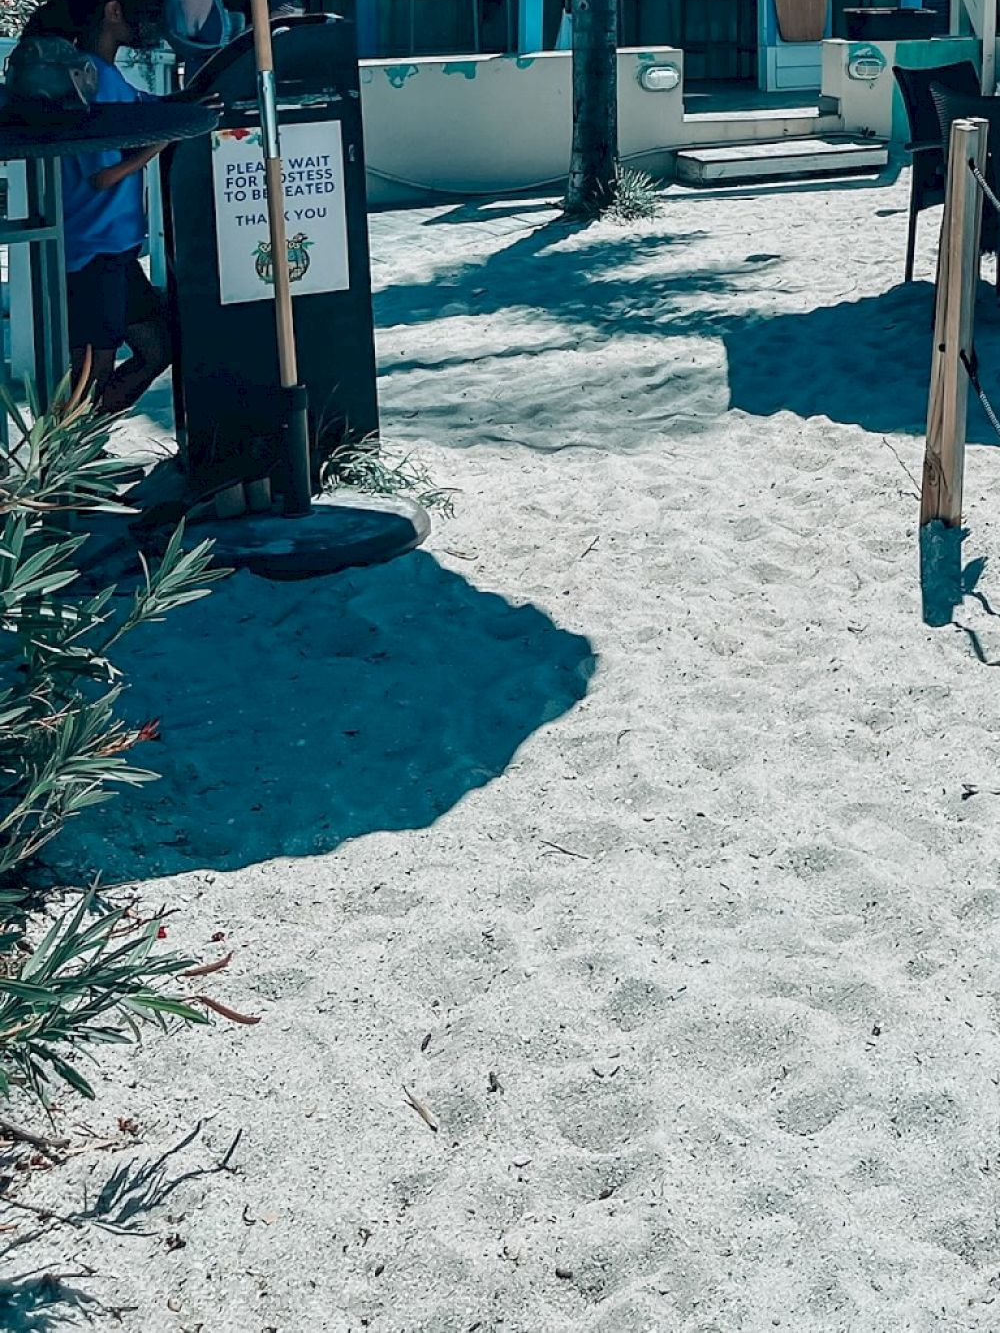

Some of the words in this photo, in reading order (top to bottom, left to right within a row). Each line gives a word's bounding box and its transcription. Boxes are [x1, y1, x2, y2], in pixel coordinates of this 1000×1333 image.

[226, 160, 284, 176] PLEA
[288, 155, 331, 170] WAIT
[224, 190, 247, 203] TO
[284, 181, 335, 197] EATED
[226, 176, 257, 189] FOR
[235, 210, 290, 227] THAK
[294, 207, 327, 220] YOU
